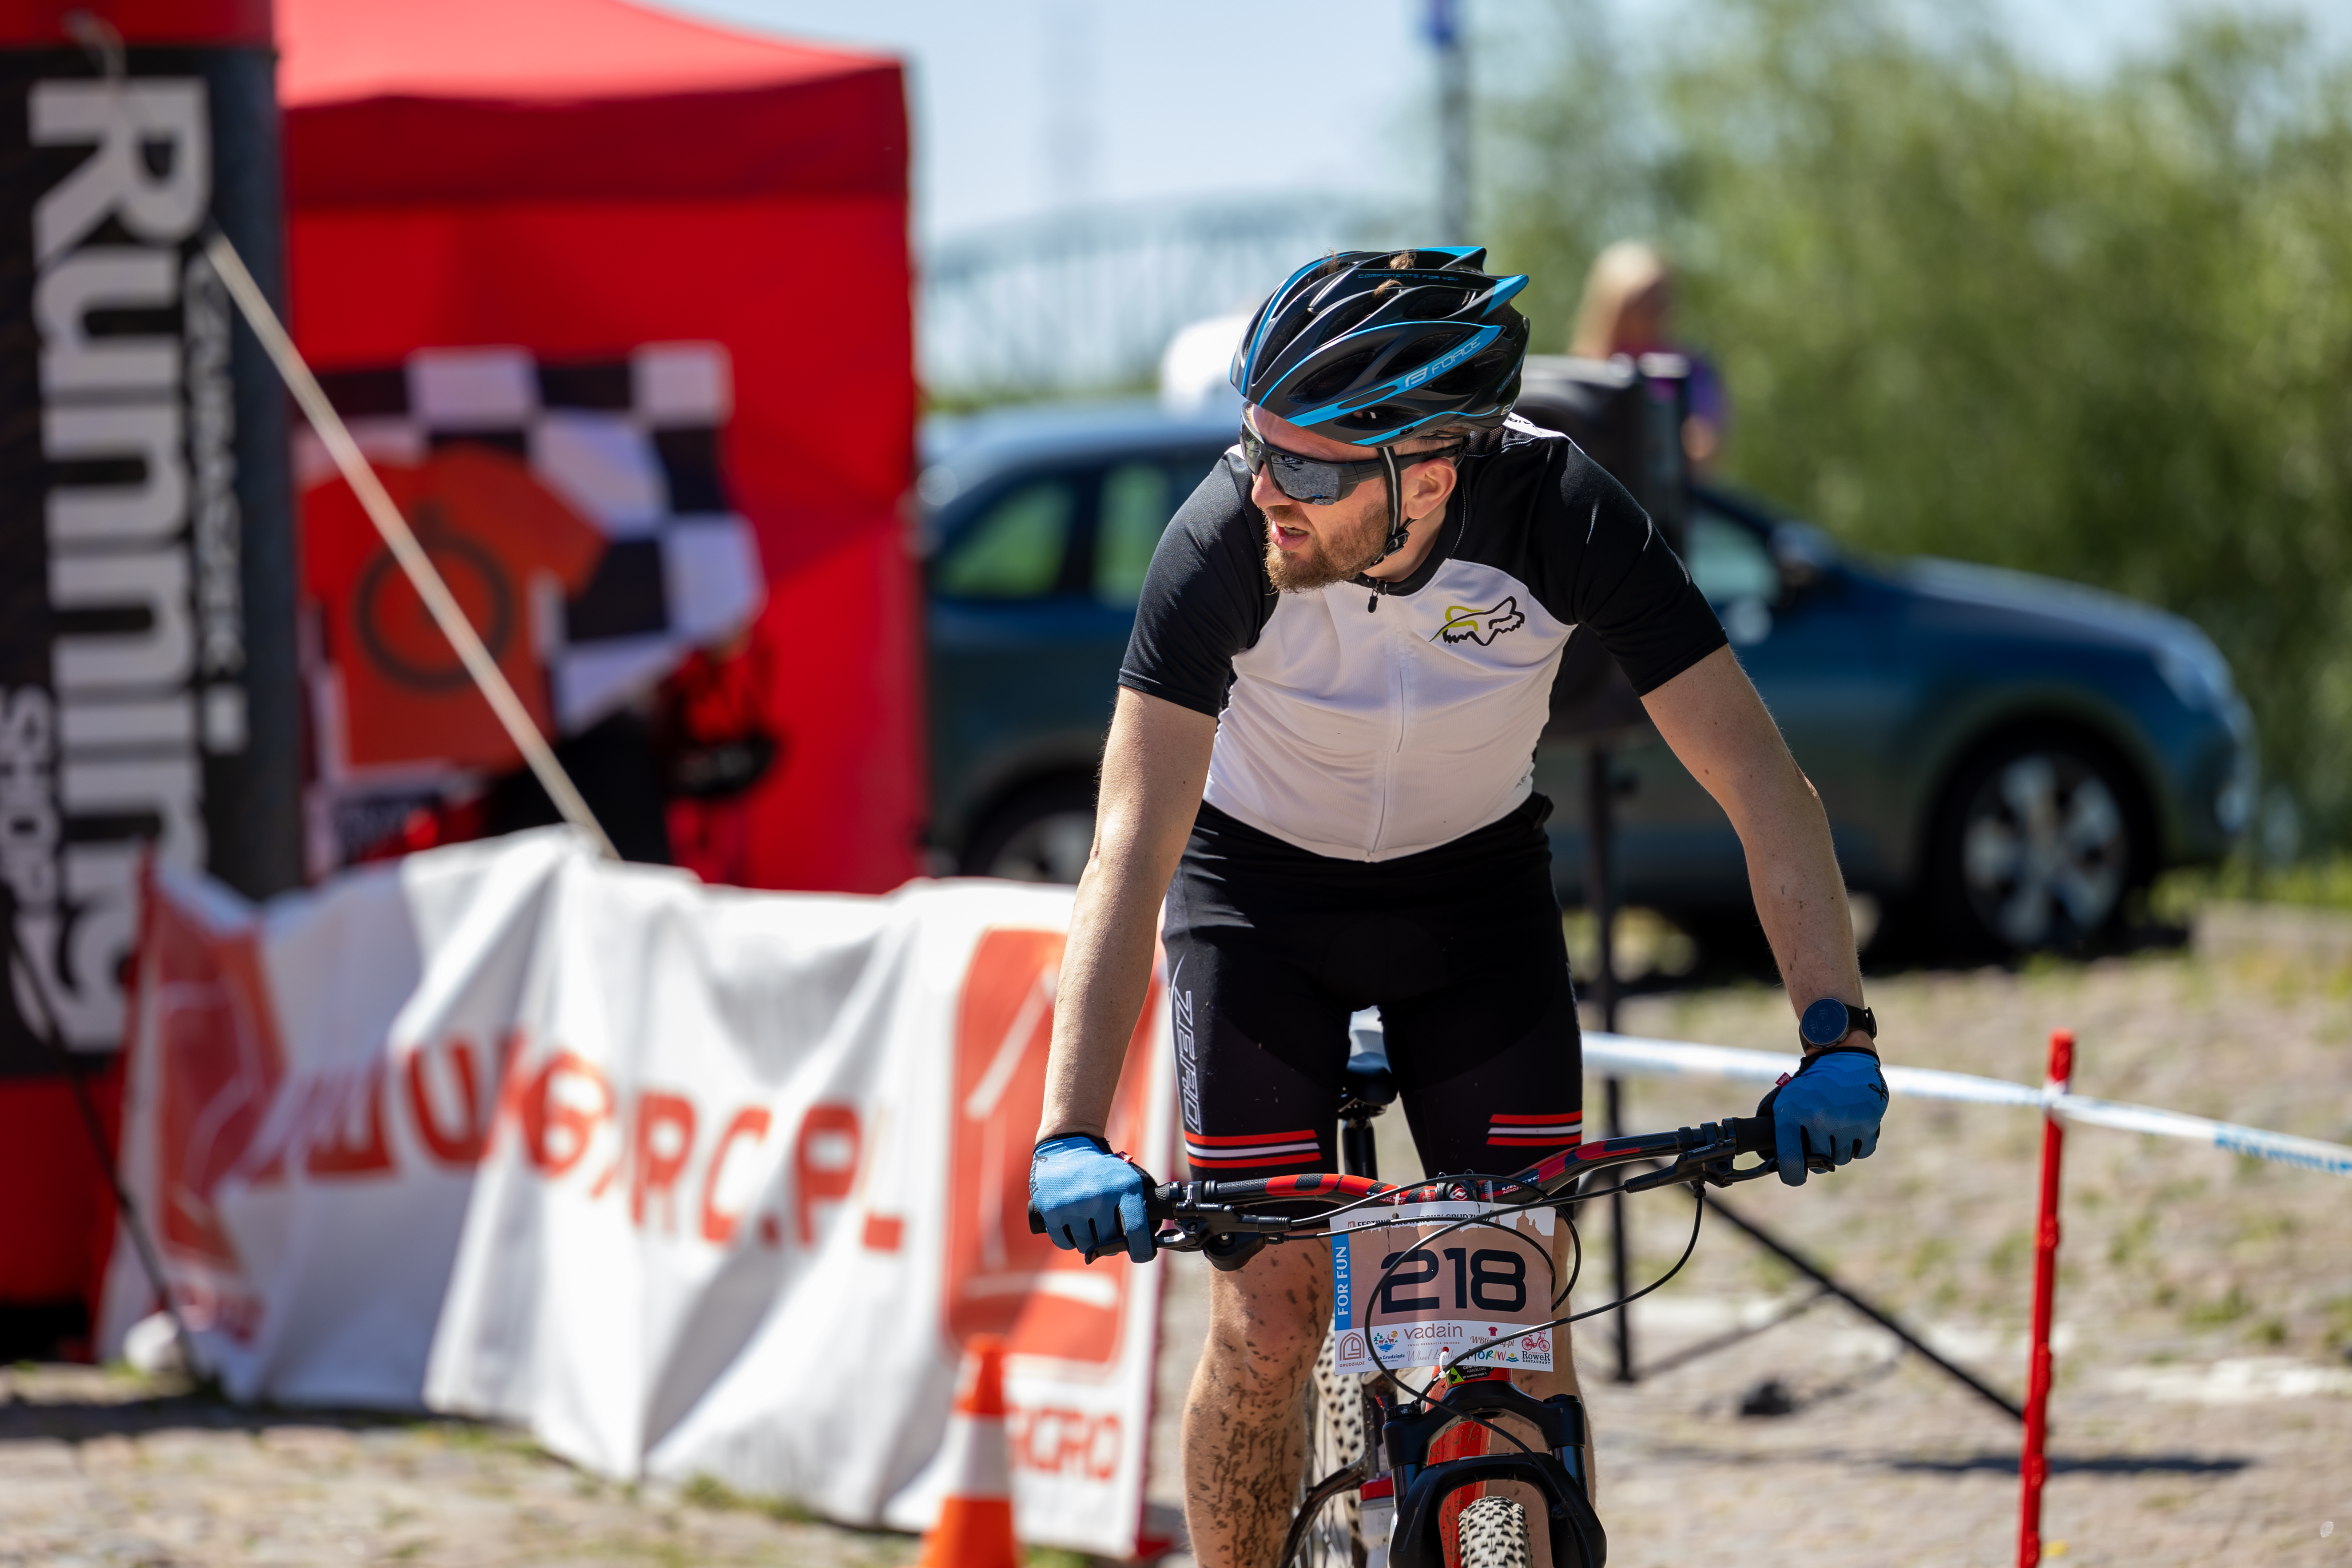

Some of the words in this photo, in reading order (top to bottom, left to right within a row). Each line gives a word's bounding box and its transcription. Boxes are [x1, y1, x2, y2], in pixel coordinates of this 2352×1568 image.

[1431, 336, 1481, 374] FORCE
[1335, 1246, 1347, 1280] FUN
[1381, 1247, 1526, 1314] 218
[1337, 1283, 1349, 1316] FOR
[1404, 1322, 1463, 1340] vadain
[1406, 1349, 1433, 1362] Wheel
